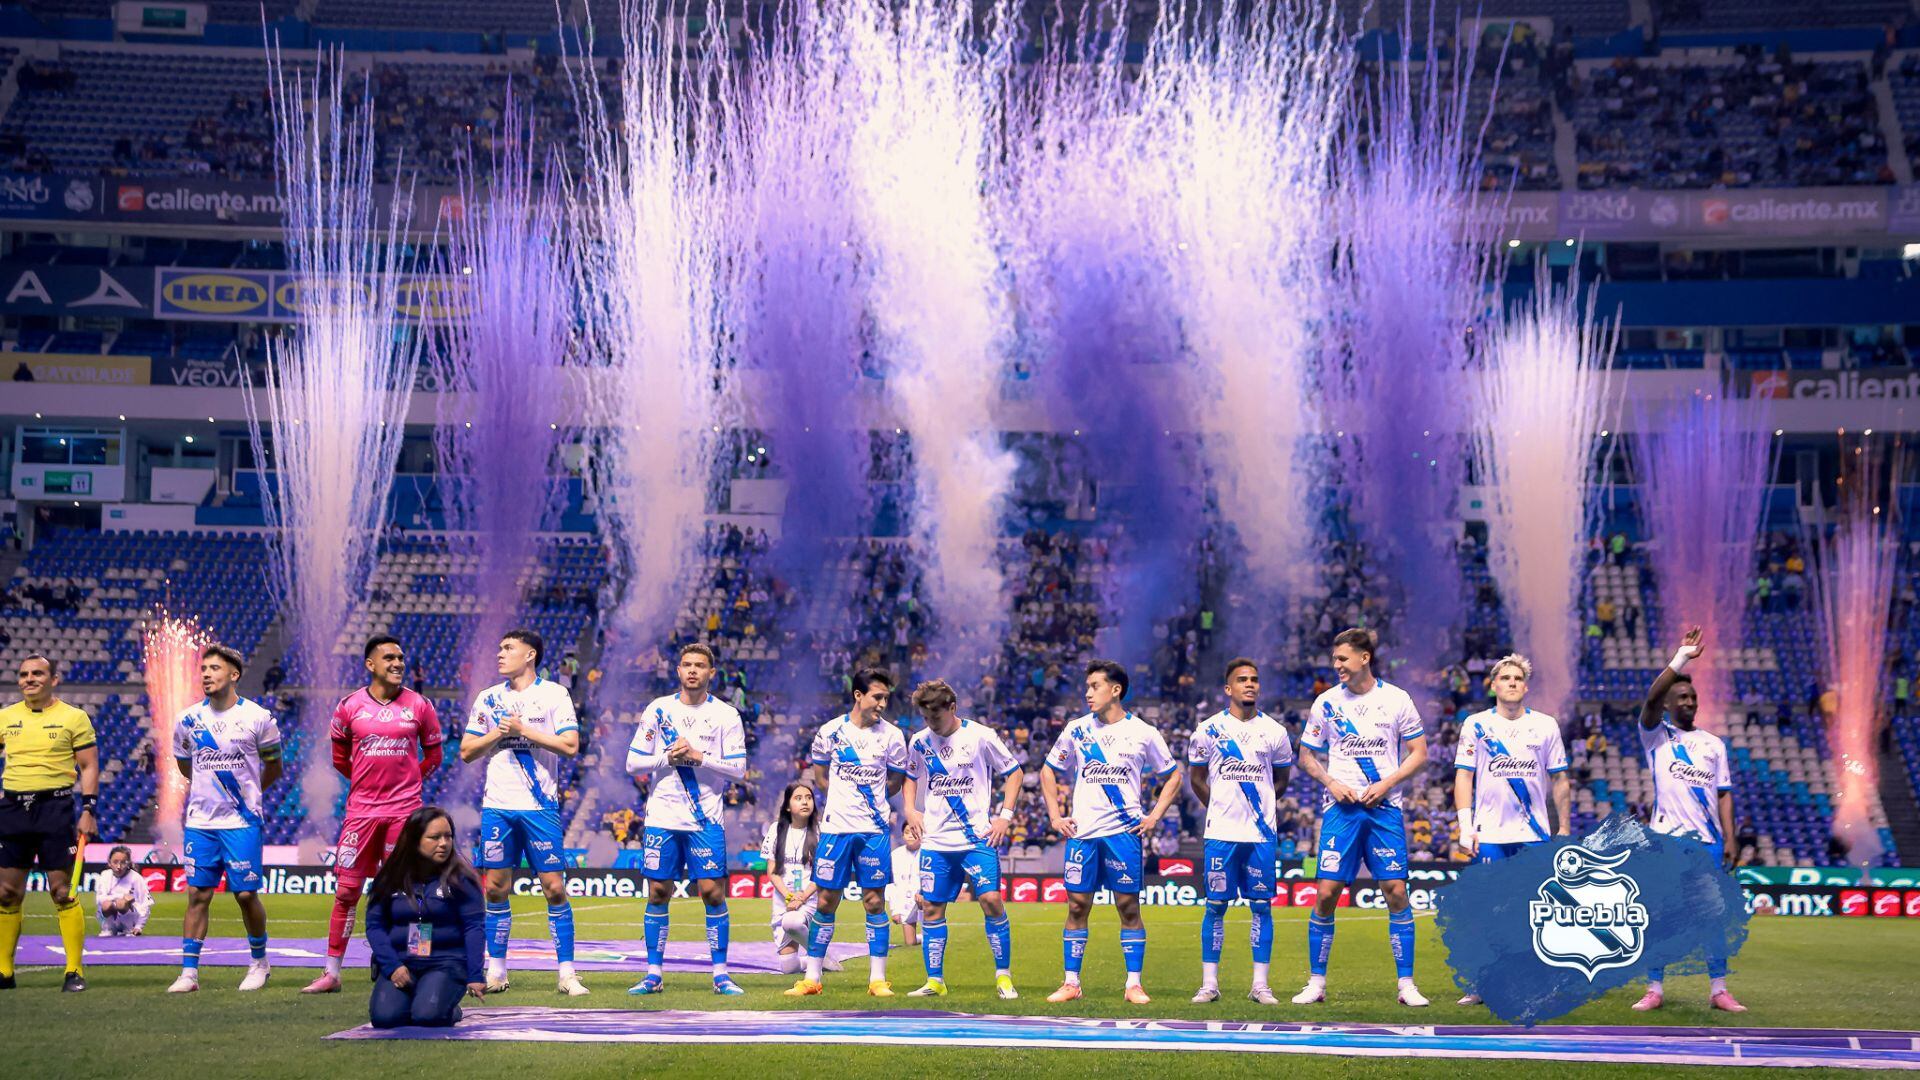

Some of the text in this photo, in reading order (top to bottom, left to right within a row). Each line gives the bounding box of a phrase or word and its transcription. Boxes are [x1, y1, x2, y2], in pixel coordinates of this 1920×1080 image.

[1731, 199, 1878, 221] caliente.mx
[172, 284, 260, 303] IKEA
[35, 366, 136, 383] GATORADE
[1340, 734, 1389, 751] Caliente
[196, 747, 246, 764] Caliente
[1082, 761, 1132, 778] Caliente
[1218, 758, 1267, 775] Caliente
[1488, 756, 1538, 772] Caliente
[928, 773, 974, 790] Caliente
[1086, 776, 1130, 785] caliente.mx
[342, 832, 359, 845] 28
[491, 826, 499, 839] 3
[186, 842, 193, 854] 6
[1326, 836, 1335, 848] 4
[825, 844, 834, 856] 7
[1069, 848, 1083, 862] 16
[921, 856, 932, 869] 12
[1210, 857, 1223, 870] 15
